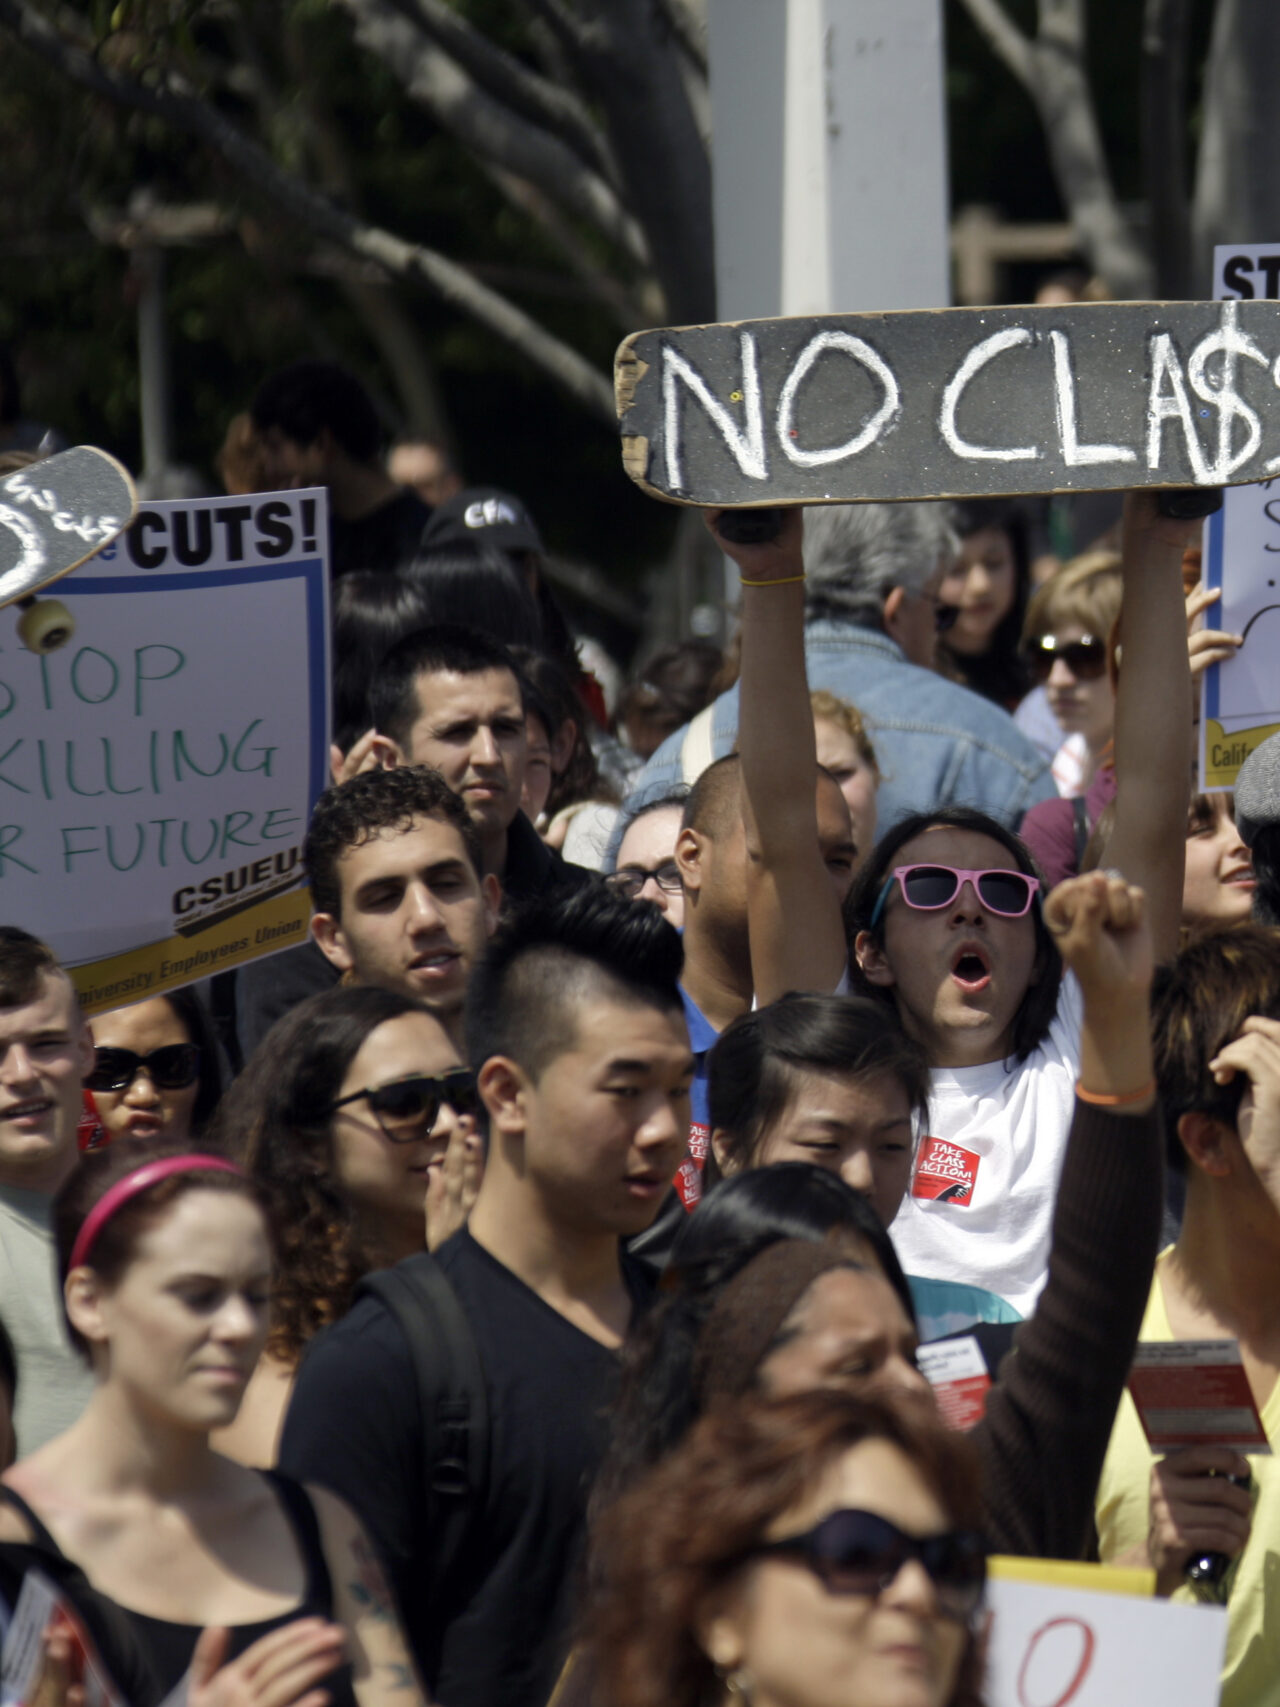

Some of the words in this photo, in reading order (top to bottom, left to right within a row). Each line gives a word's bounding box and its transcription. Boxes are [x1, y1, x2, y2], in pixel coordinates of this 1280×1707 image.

[661, 329, 900, 491] NO
[126, 498, 317, 569] CUTS!
[1212, 742, 1256, 767] Calif
[60, 808, 302, 874] FUTURE
[172, 846, 299, 915] CSUEU
[160, 934, 249, 979] Employees
[255, 918, 303, 945] Union
[920, 1160, 972, 1182] ACTION!
[929, 1152, 966, 1169] CLASS
[933, 1142, 965, 1158] TAKE
